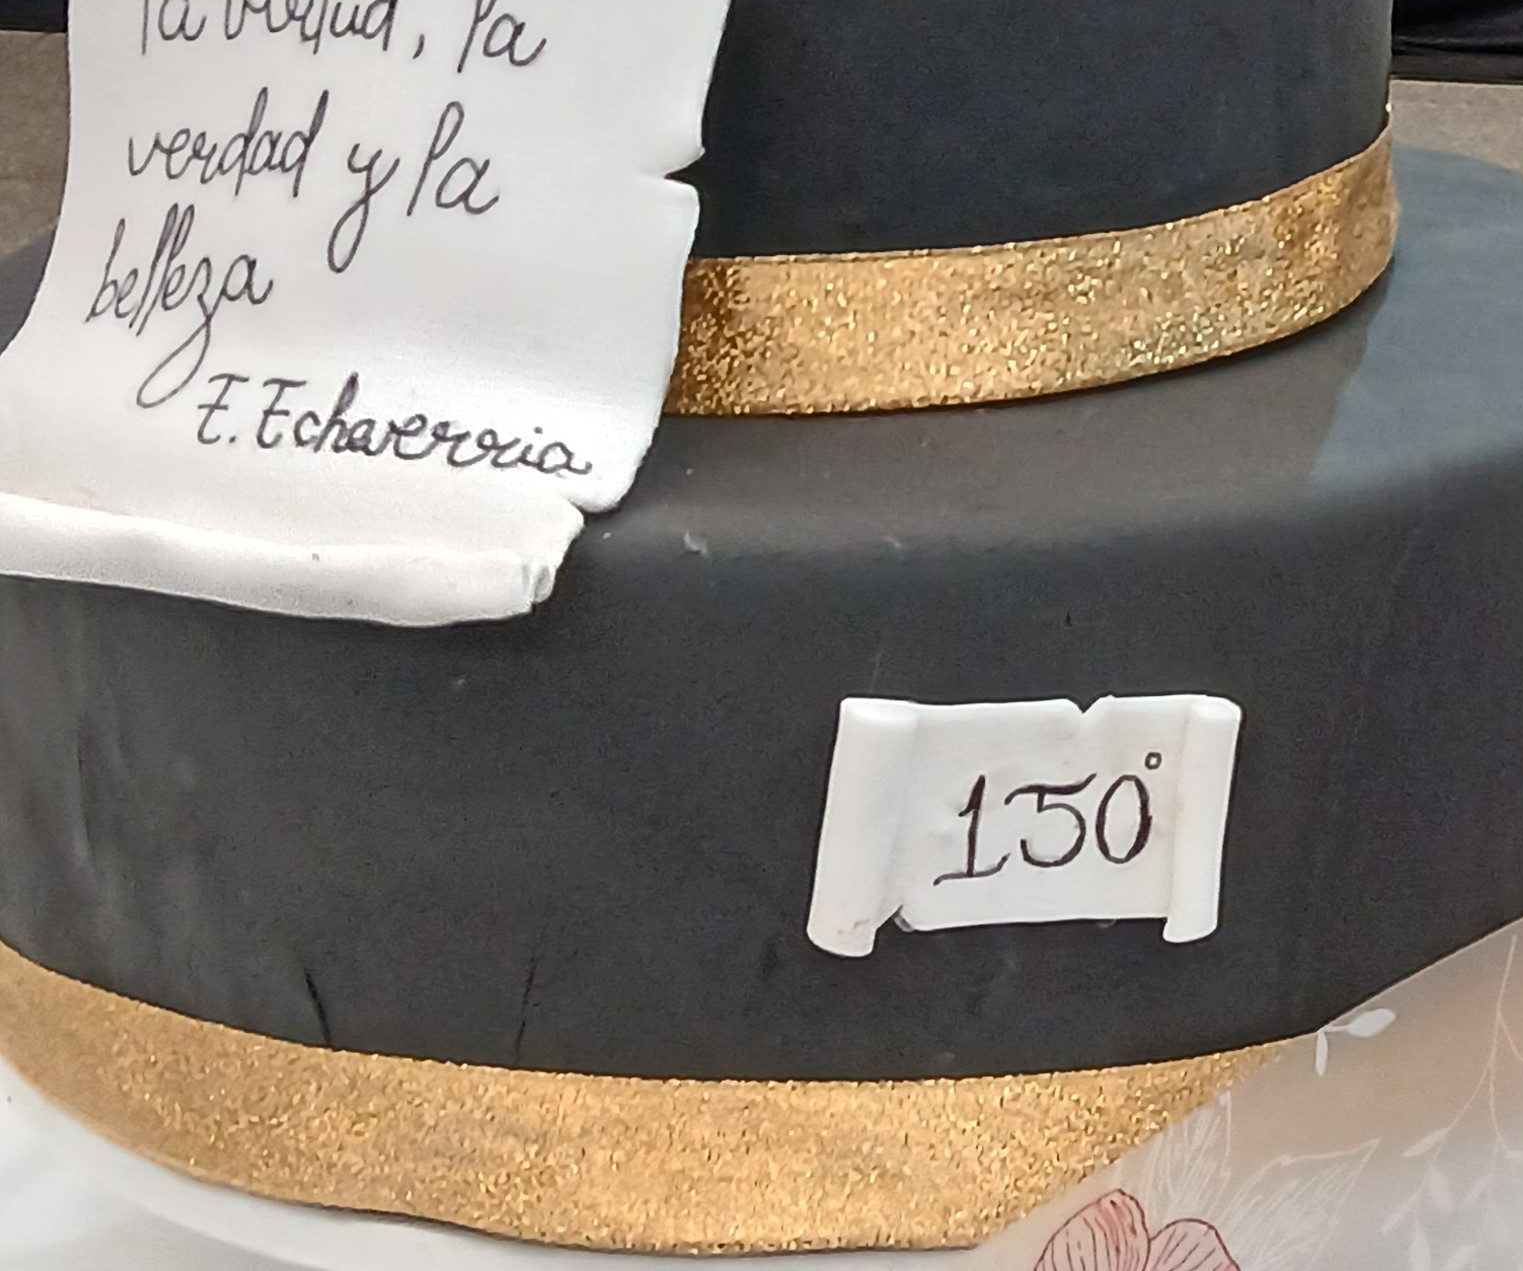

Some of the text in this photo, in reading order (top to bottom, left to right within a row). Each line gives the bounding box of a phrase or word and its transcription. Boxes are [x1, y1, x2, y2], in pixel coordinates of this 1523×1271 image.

[128, 86, 499, 274] verdad y la
[84, 202, 274, 409] belleza
[196, 372, 250, 446] E.
